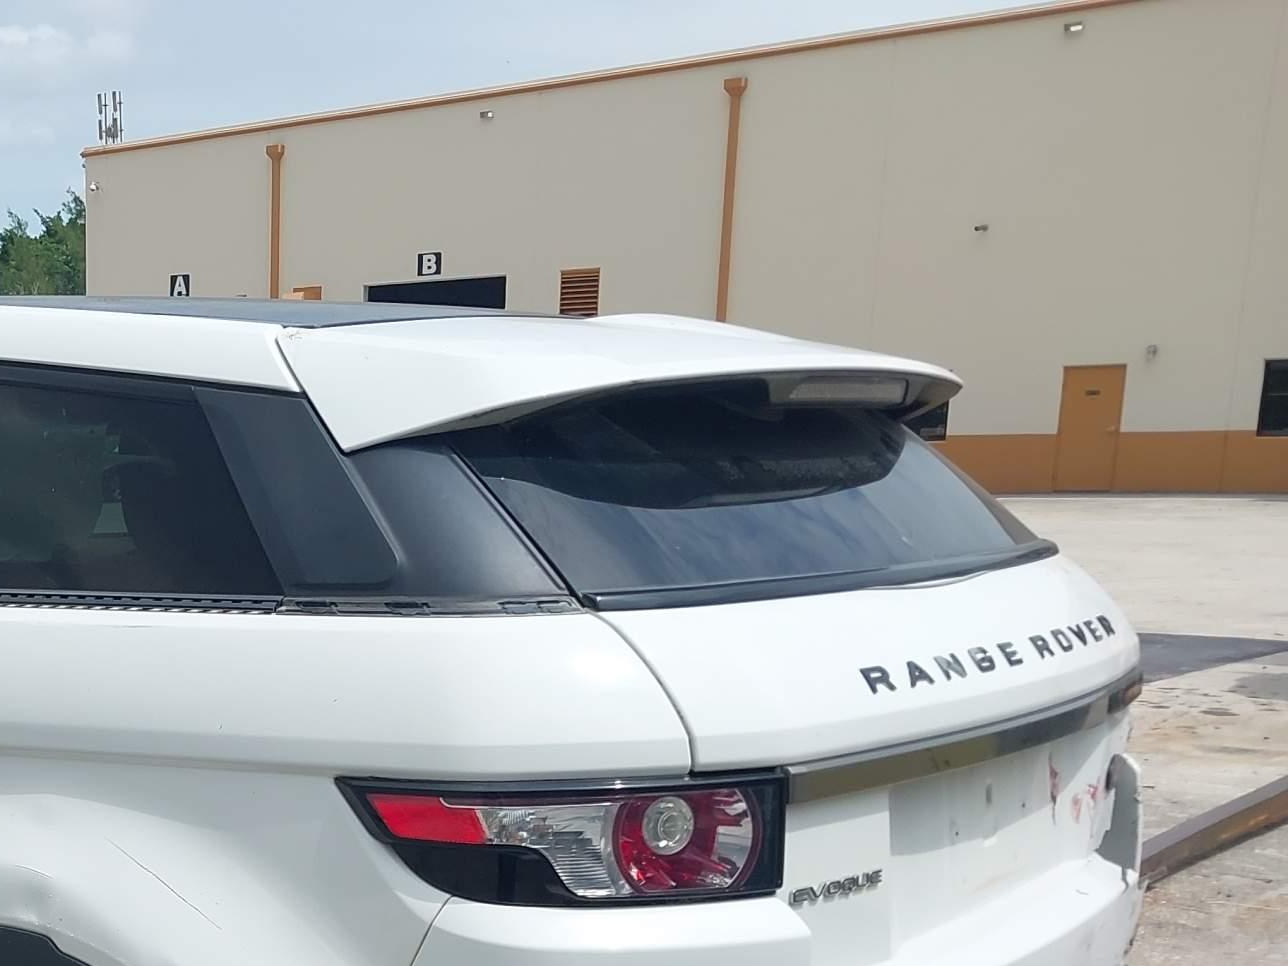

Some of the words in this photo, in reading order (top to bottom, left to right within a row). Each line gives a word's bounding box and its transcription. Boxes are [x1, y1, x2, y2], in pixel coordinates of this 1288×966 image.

[422, 254, 437, 275] B
[173, 275, 188, 297] A
[859, 641, 1024, 695] RANGE
[1028, 614, 1116, 660] ROVER
[791, 868, 883, 905] EVOQUE
